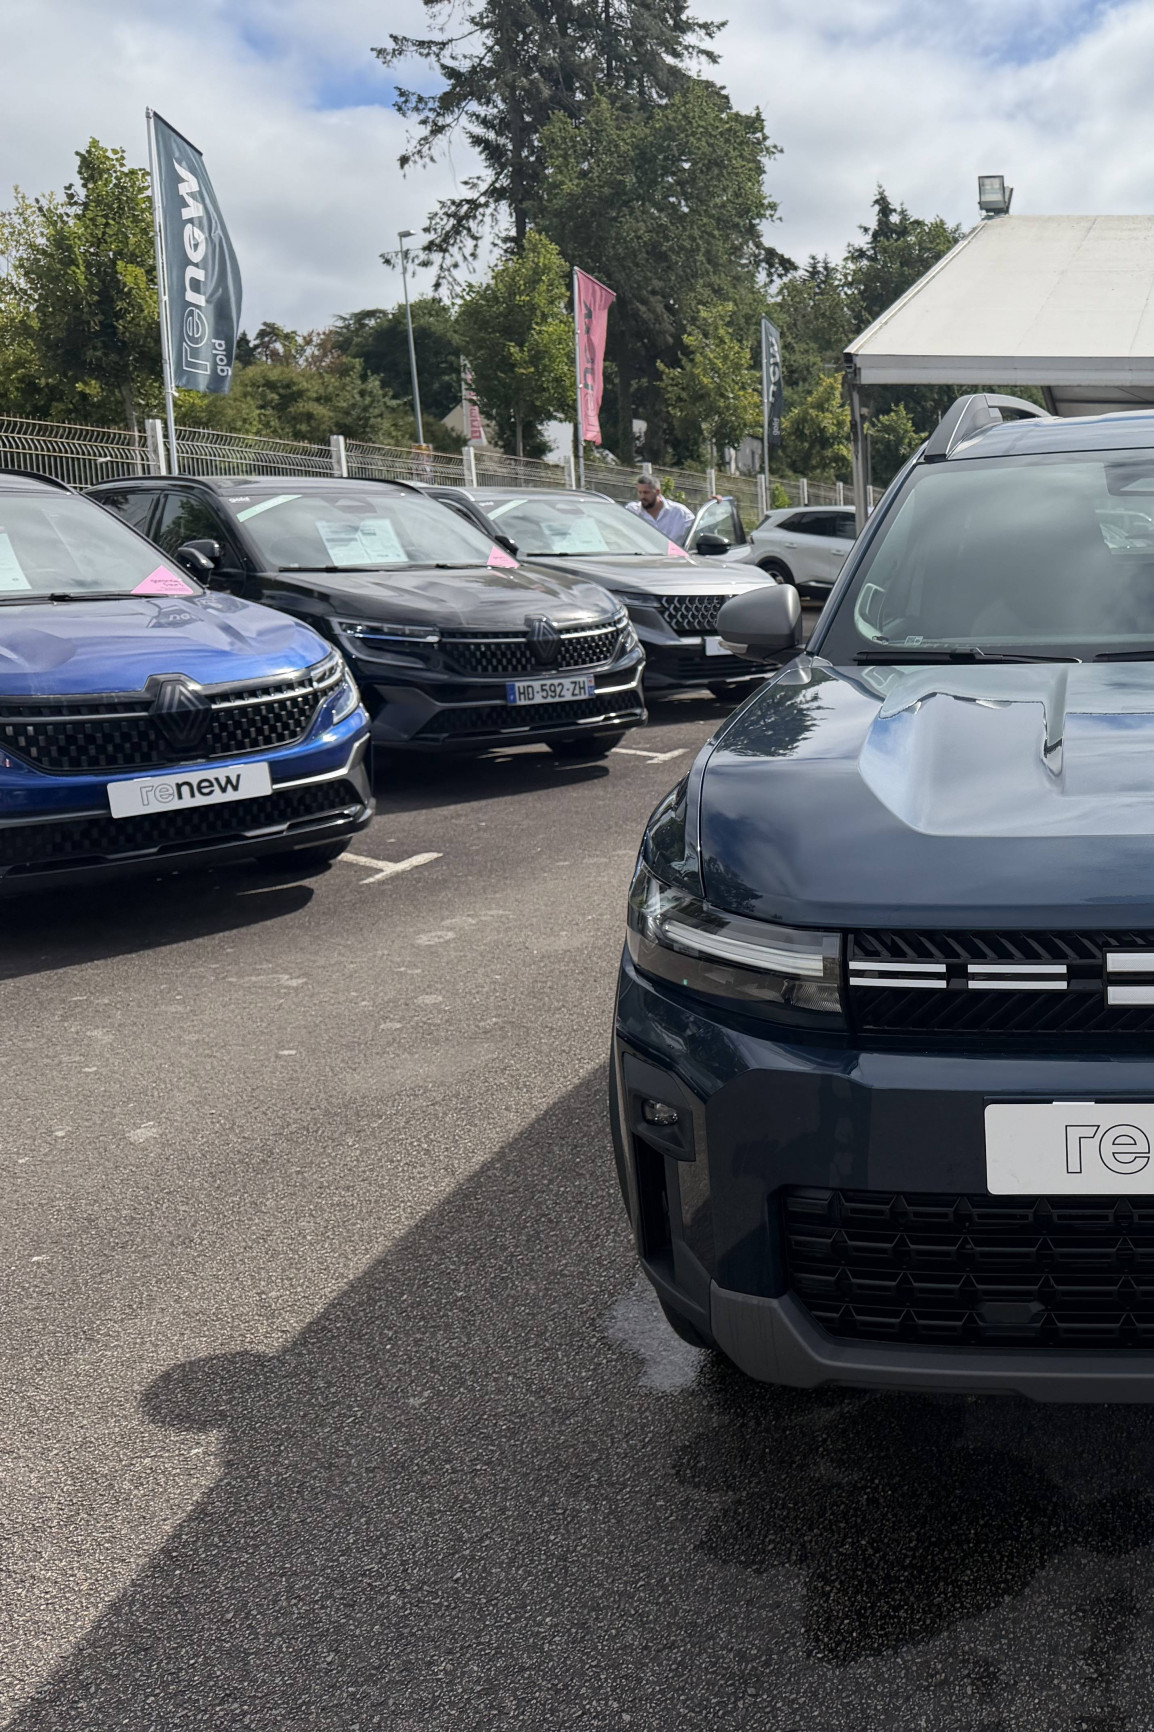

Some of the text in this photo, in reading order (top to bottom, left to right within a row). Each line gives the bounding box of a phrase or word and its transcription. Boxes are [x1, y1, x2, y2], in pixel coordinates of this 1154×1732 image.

[172, 158, 211, 375] renew
[211, 339, 232, 378] gold
[517, 680, 587, 702] HD-592-ZH
[139, 773, 242, 807] renew
